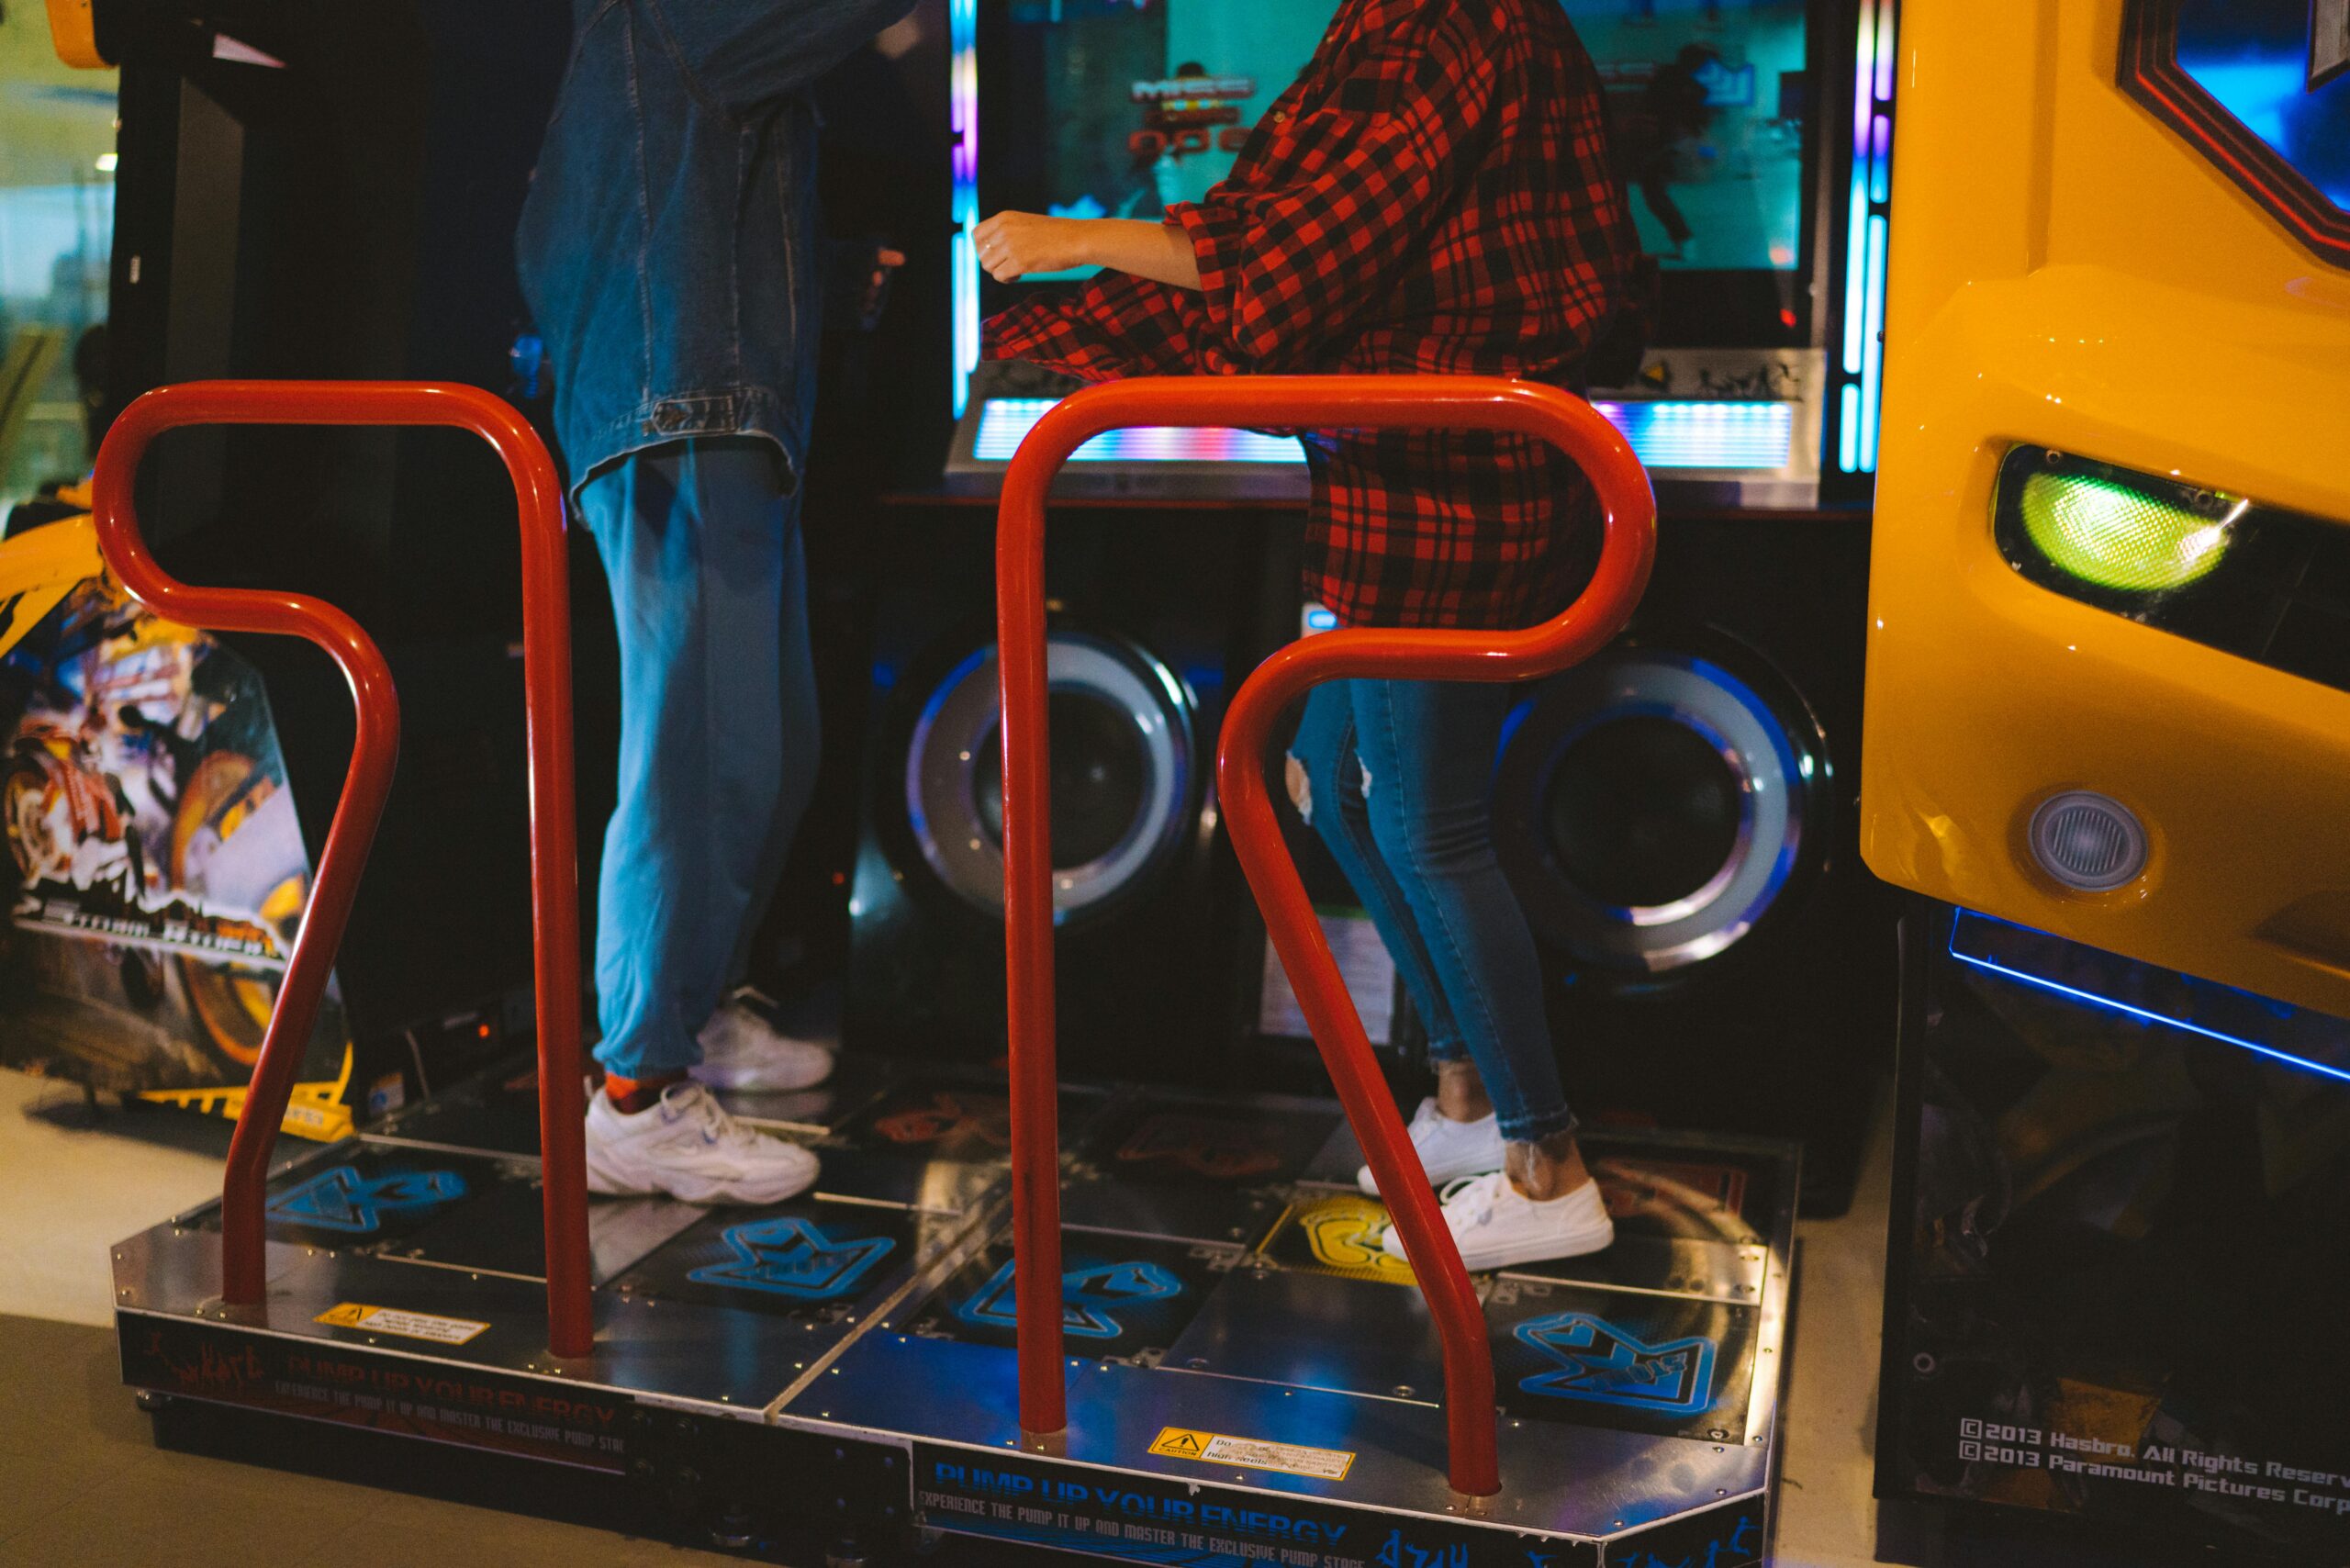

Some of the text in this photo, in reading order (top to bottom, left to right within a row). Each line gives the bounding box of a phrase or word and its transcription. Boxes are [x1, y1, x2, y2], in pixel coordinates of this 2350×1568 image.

[415, 1375, 494, 1408] YOUR
[498, 1389, 615, 1428] ENERGY
[486, 1416, 503, 1433] THE
[507, 1419, 562, 1442] EXCLUSIVE
[565, 1429, 595, 1448] PUMP
[1158, 1447, 1198, 1458] CAUTION
[2050, 1431, 2135, 1458] Hasbro.
[2143, 1444, 2175, 1464] All
[2181, 1449, 2259, 1475] Rights
[2048, 1454, 2176, 1487] Paramount
[2183, 1472, 2286, 1503] Pictures
[918, 1490, 986, 1516] EXPERIENCE
[990, 1501, 1013, 1521] THE
[1017, 1506, 1053, 1527] PUMP
[1058, 1512, 1072, 1529] IT
[1075, 1515, 1091, 1532] UP
[1095, 1519, 1120, 1538] AND
[1124, 1523, 1175, 1546] MASTER
[1181, 1531, 1204, 1551] THE
[1209, 1537, 1275, 1562] EXCLUSIVE
[1281, 1548, 1318, 1568] PUMP
[934, 1462, 1349, 1548] PUMP UP YOUR ENERGY
